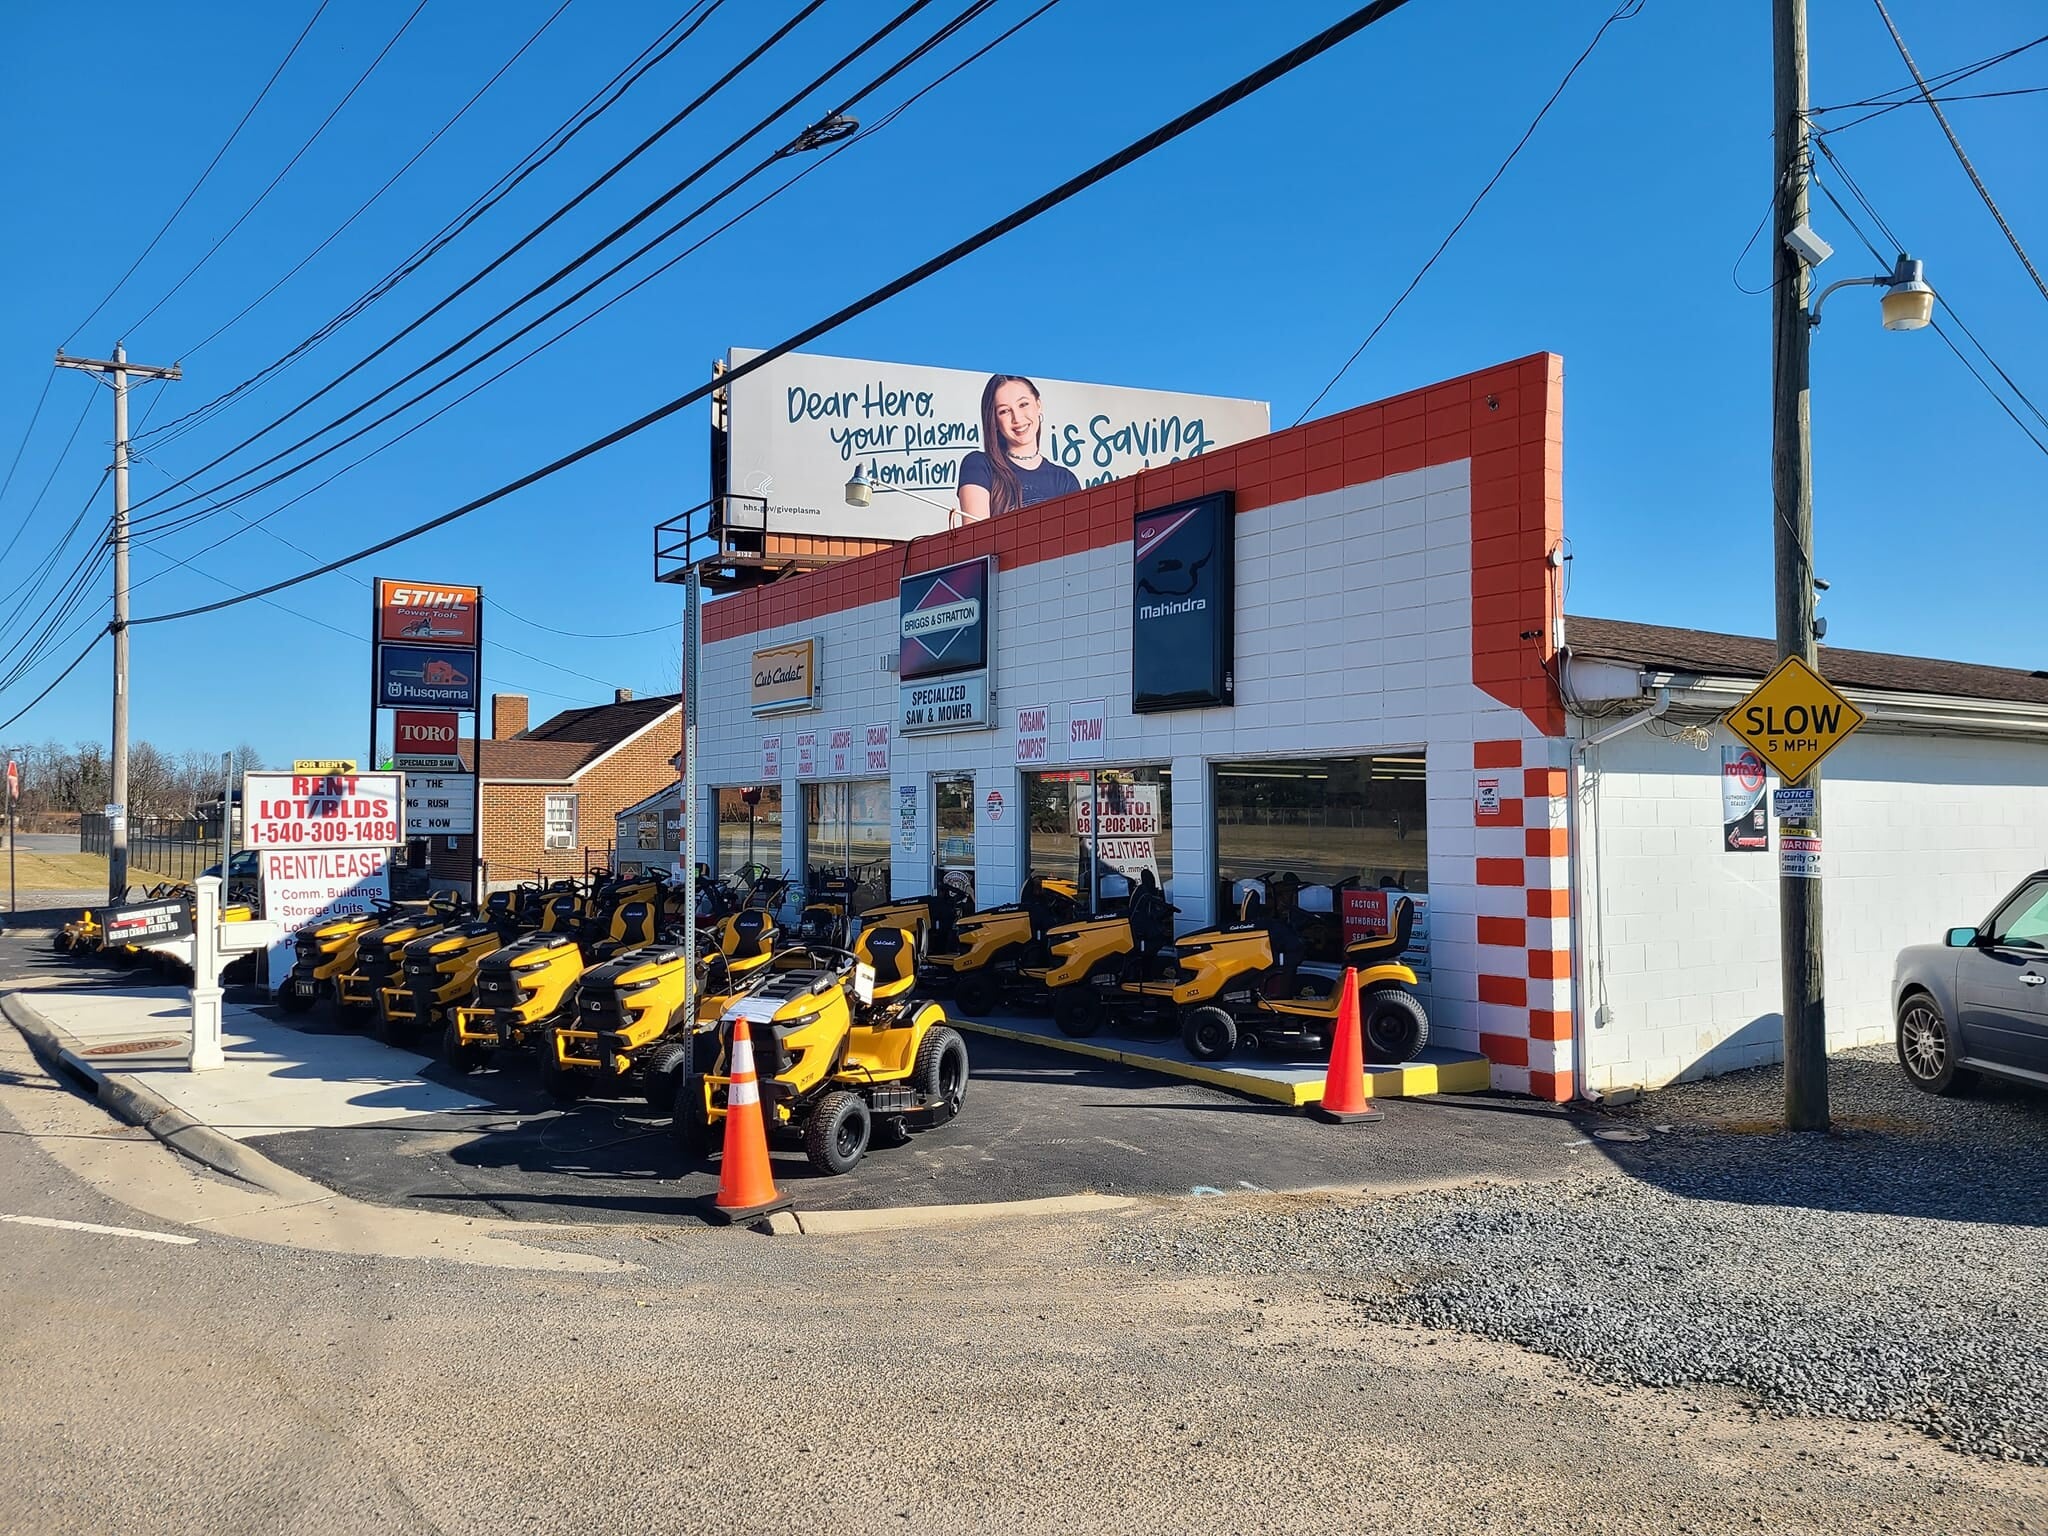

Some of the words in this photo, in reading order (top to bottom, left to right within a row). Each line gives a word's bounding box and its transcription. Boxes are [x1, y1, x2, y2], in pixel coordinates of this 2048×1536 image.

[787, 386, 858, 423] Dear
[862, 381, 935, 418] Hero,
[830, 424, 899, 461] your
[904, 422, 980, 456] plasma
[1051, 424, 1086, 467] is
[867, 457, 957, 485] donation
[390, 588, 469, 611] STIHL
[1140, 598, 1206, 619] Mahindra
[398, 608, 430, 616] Power
[432, 610, 458, 619] Tools
[904, 615, 930, 632] BRIGGS
[931, 615, 936, 626] &
[937, 606, 975, 625] STRATTON
[754, 670, 773, 688] Cub
[772, 665, 805, 684] Cadet
[403, 685, 469, 700] Husqvarna
[912, 685, 966, 706] SPECIALIZED
[906, 709, 924, 725] SAW
[928, 709, 934, 722] &
[938, 703, 972, 722] MOWER
[1019, 710, 1046, 733] ORGANIC
[1746, 704, 1842, 736] SLOW
[400, 725, 455, 741] TORO
[866, 725, 888, 746] ORGANIC
[1071, 718, 1103, 743] STRAW
[1017, 737, 1046, 760] COMPOST
[1768, 739, 1778, 752] 5
[1784, 739, 1818, 752] MPH
[297, 761, 317, 769] FOR
[318, 760, 344, 769] RENT
[399, 759, 439, 767] SPECIALIZED
[867, 750, 886, 769] TOPSOIL
[292, 776, 359, 796] RENT
[426, 780, 443, 788] THE
[1776, 790, 1812, 798] NOTICE
[260, 800, 388, 819] LOT/BLDS
[428, 799, 449, 808] RUSH
[251, 821, 396, 843] 1-540-309-1489
[428, 819, 450, 827] NOW
[270, 853, 383, 880] RENT/LEASE
[282, 889, 324, 900] Comm.
[328, 887, 382, 902] Buildings
[1351, 899, 1380, 909] FACTORY
[283, 905, 329, 918] Storage
[333, 903, 363, 914] Units
[1345, 916, 1386, 926] AUTHORIZED
